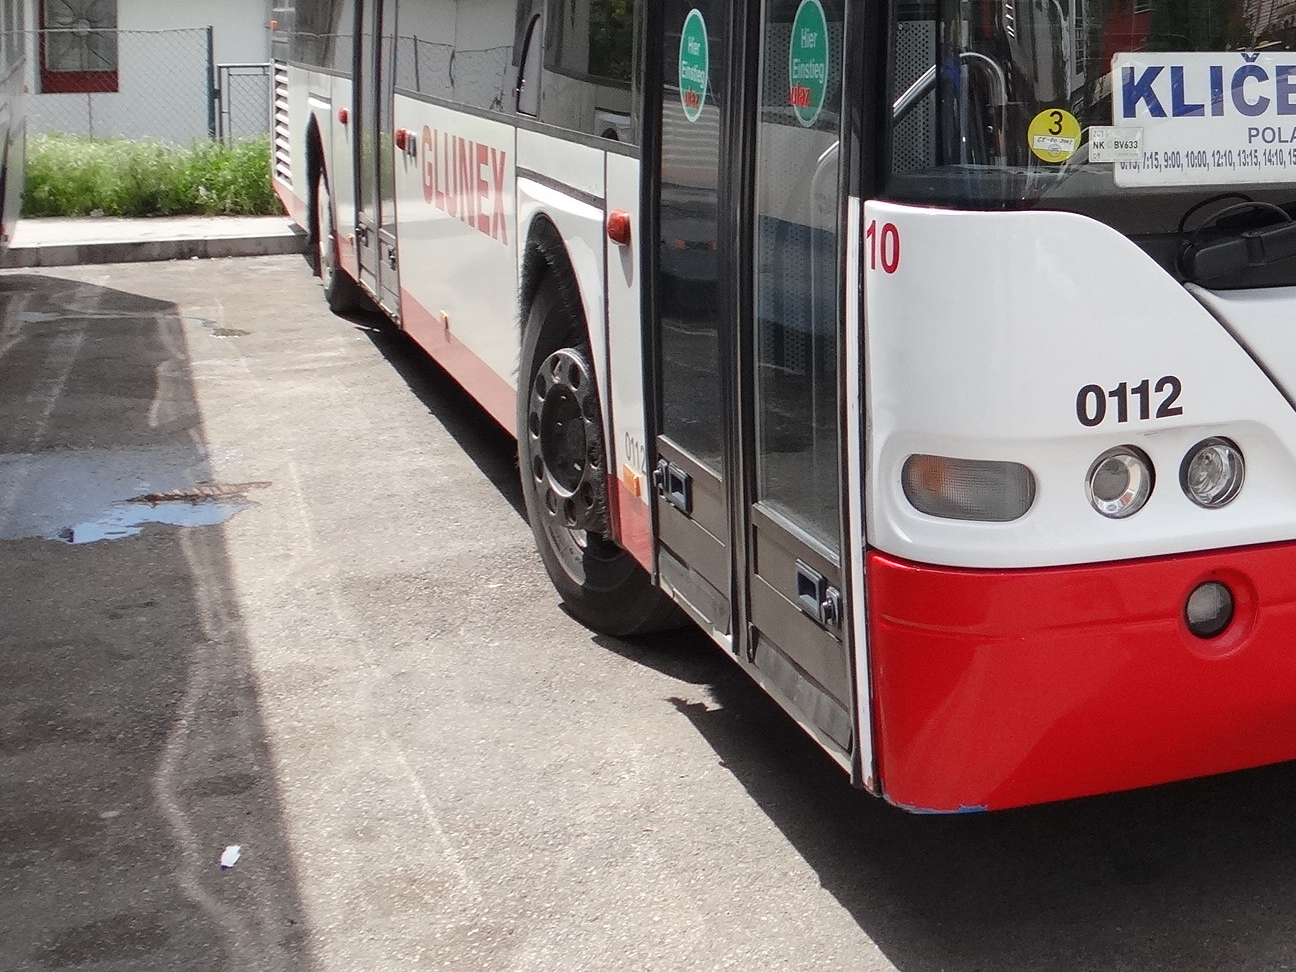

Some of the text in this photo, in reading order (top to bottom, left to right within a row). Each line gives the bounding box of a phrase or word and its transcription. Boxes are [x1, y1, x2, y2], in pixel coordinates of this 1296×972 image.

[801, 27, 818, 49] Hier
[792, 57, 825, 85] Einstieg
[1048, 110, 1063, 135] 3
[1093, 140, 1138, 149] NK BV633
[1163, 151, 1184, 172] 9:00,
[1186, 150, 1210, 171] 10:00,
[1212, 149, 1235, 171] 12:10,
[1237, 149, 1261, 170] 13:15,
[1263, 148, 1286, 169] 14:10,
[421, 124, 508, 246] GLUNEX
[867, 219, 900, 274] 10
[1075, 374, 1184, 427] 0112
